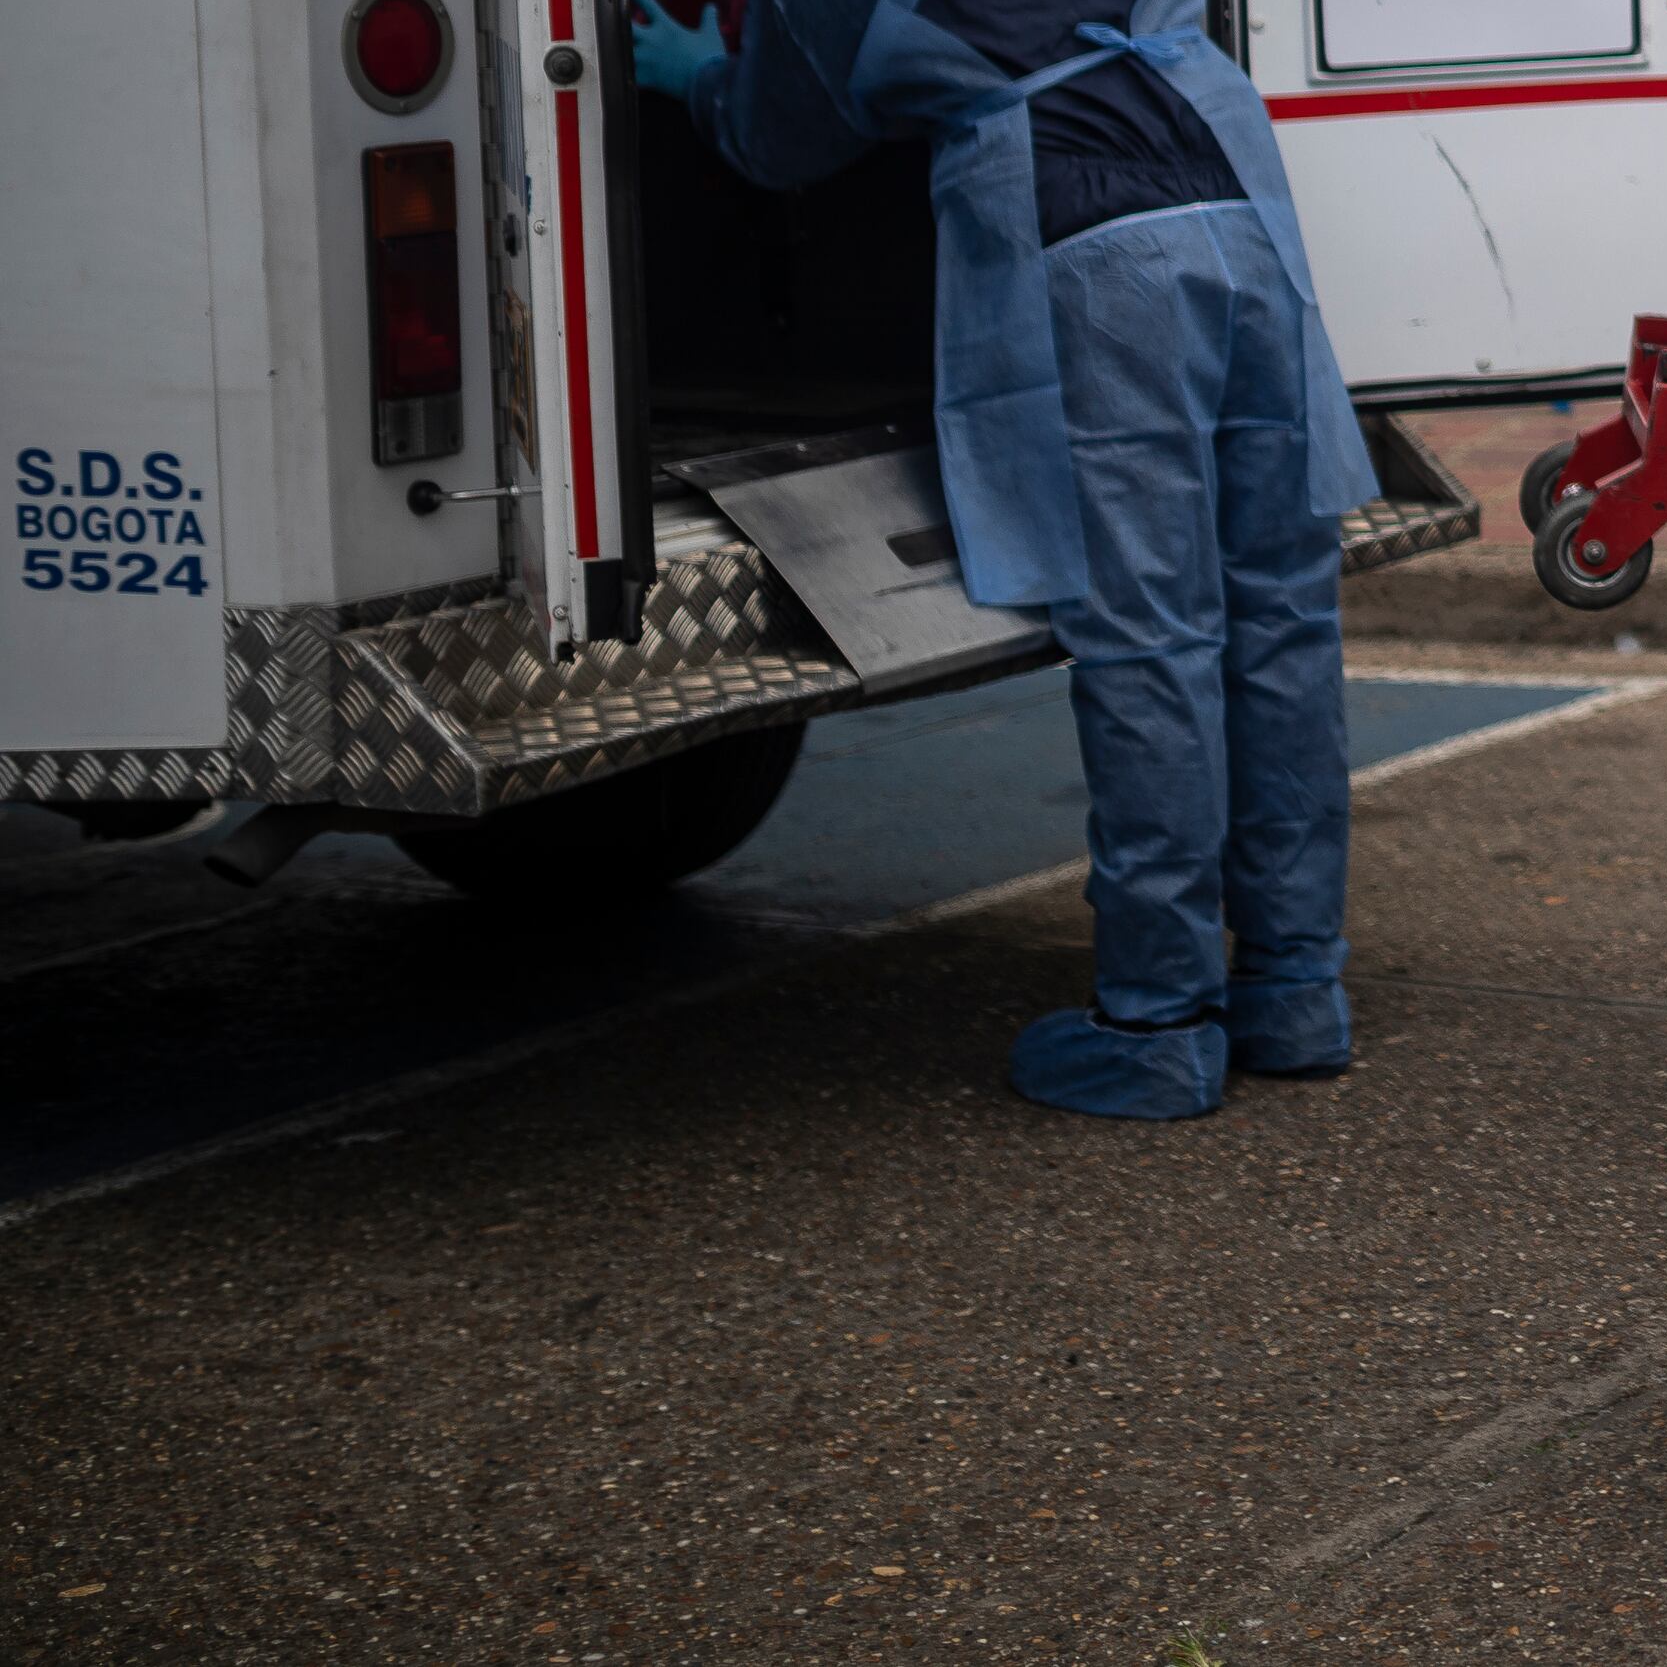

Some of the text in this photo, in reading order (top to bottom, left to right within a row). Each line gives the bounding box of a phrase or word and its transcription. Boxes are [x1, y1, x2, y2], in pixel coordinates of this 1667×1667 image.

[16, 447, 203, 501] S.D.S.
[16, 503, 206, 546] BOGOTA
[21, 548, 208, 597] 5524
